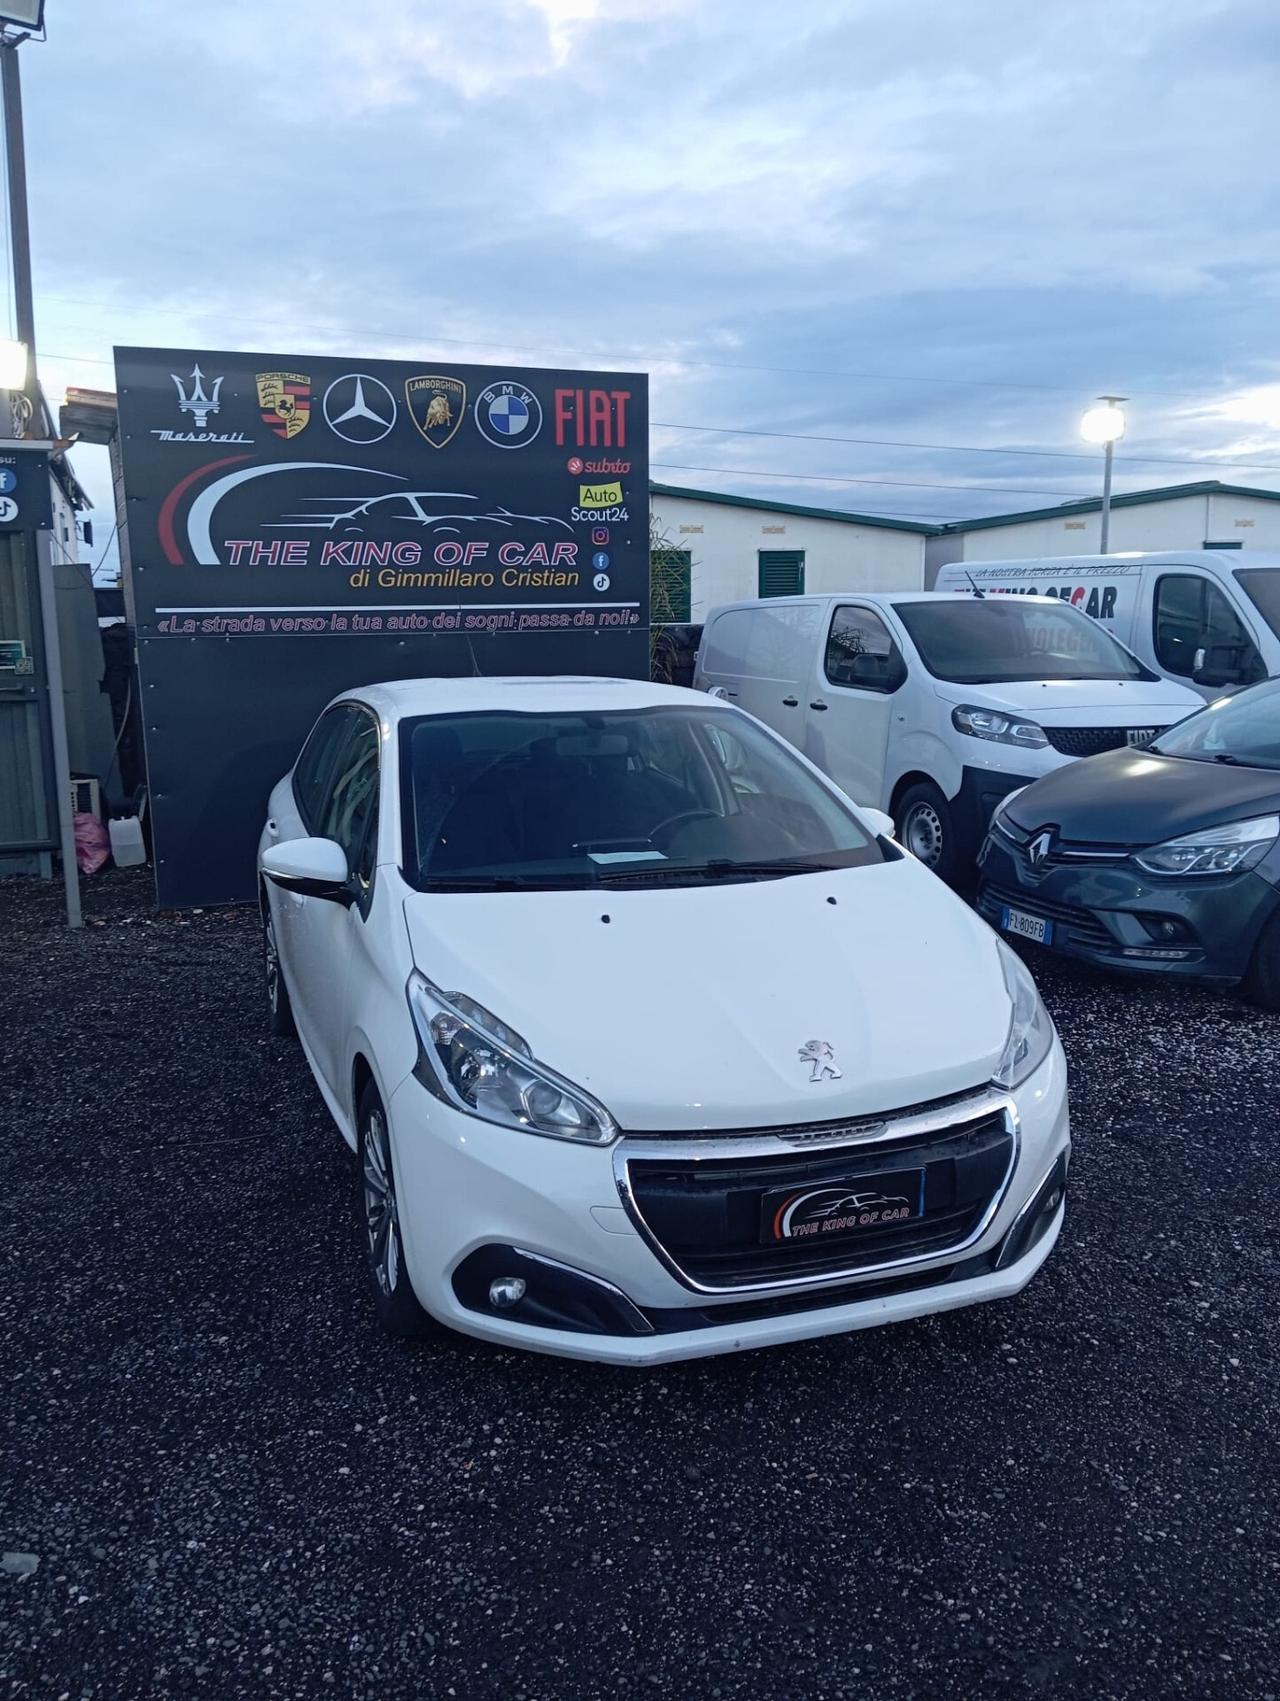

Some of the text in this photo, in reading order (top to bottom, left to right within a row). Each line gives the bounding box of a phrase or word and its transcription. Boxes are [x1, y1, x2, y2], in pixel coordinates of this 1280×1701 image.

[256, 373, 309, 383] PORSCHE
[409, 380, 462, 393] LAMBORGHINI
[555, 389, 631, 447] FIAT
[150, 430, 255, 444] Maserati
[585, 458, 632, 473] subito
[583, 488, 618, 502] Auto
[571, 506, 629, 521] Scout24
[224, 540, 578, 566] THE KING OF CAR
[350, 568, 579, 588] di Gimmillaro Cristian
[201, 614, 267, 633] strada
[270, 616, 326, 632] verso
[331, 613, 348, 631] la
[352, 614, 382, 630] tua
[387, 613, 428, 630] auto
[432, 611, 461, 629] dei
[465, 611, 515, 632] sogni
[518, 614, 572, 632] passa
[573, 610, 594, 626] da
[792, 1207, 910, 1237] THE KING OF CAR
